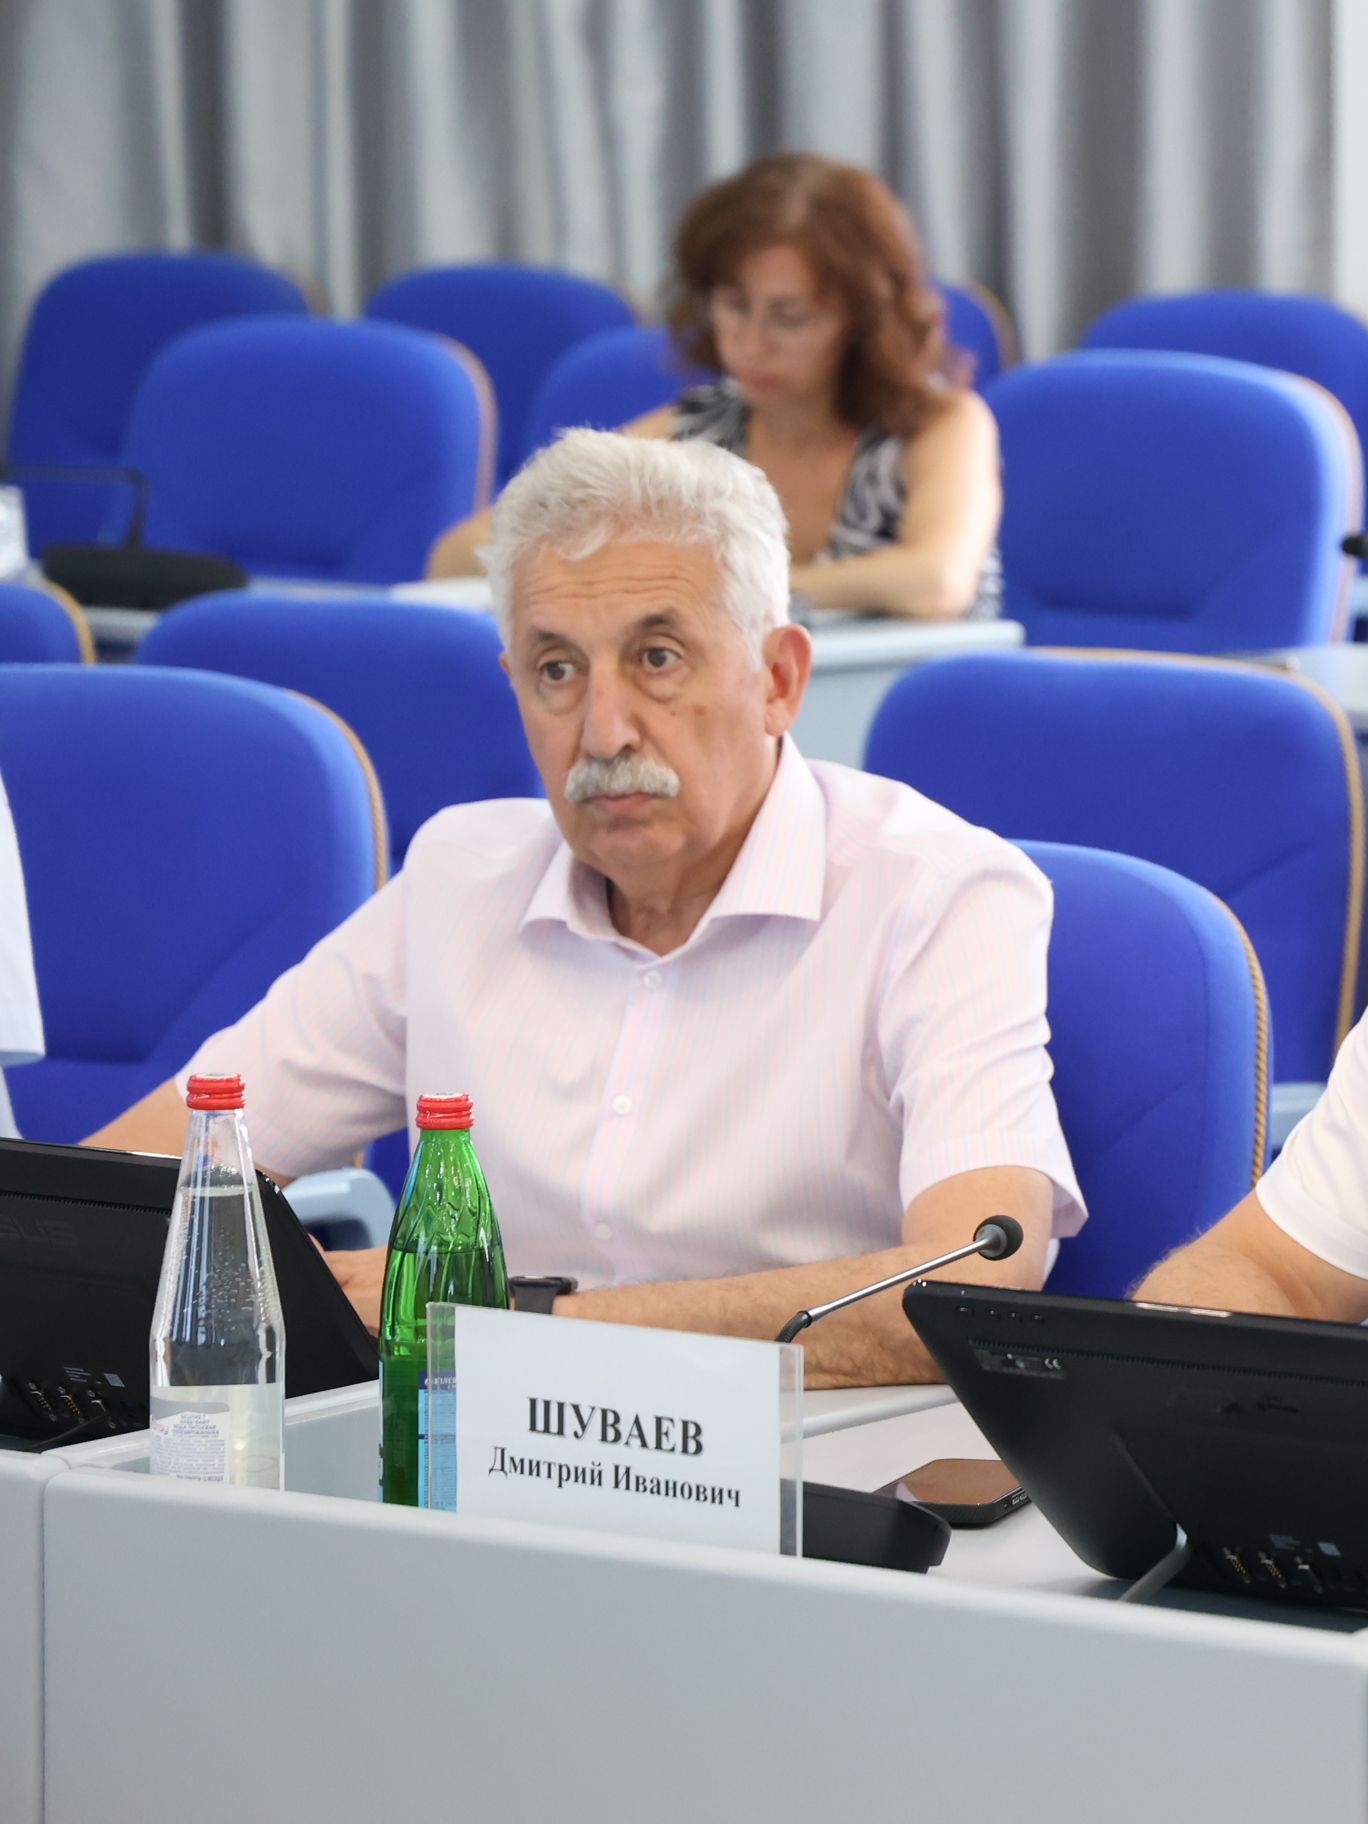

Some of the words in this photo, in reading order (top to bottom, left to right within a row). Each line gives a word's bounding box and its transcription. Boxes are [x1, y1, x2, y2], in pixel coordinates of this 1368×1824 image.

[527, 1397, 704, 1456] ШУВАЕВ
[488, 1446, 604, 1488] Дмитрий
[613, 1463, 741, 1507] Иванович
